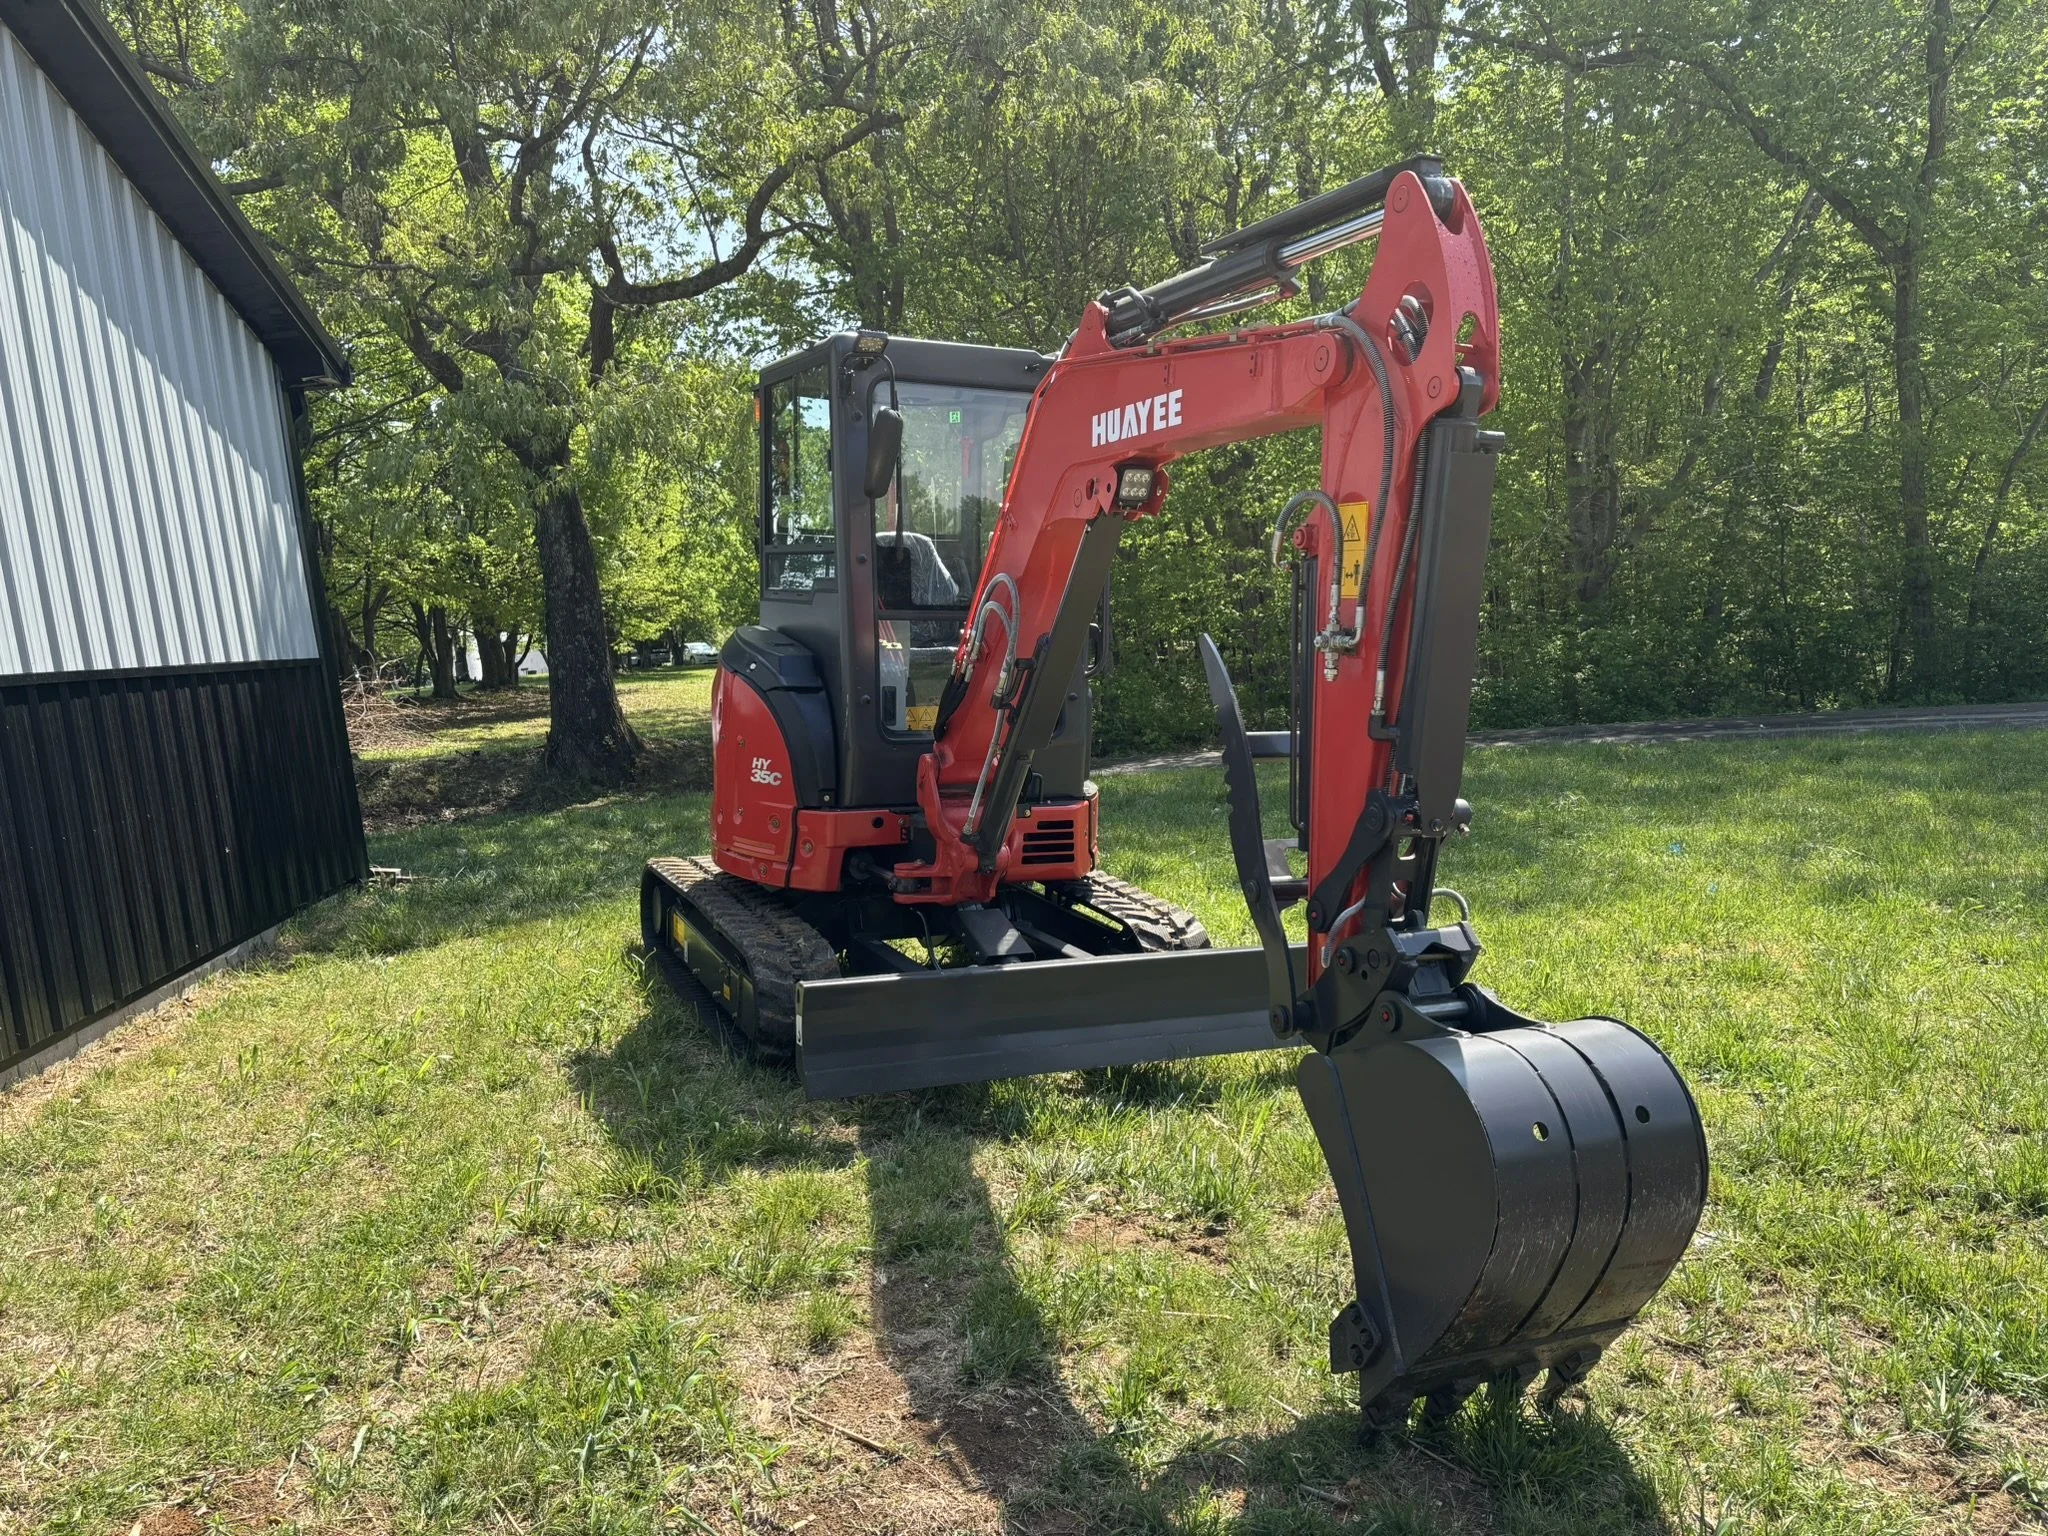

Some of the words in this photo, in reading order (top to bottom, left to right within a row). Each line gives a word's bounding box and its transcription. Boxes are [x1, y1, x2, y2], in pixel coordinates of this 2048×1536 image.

[1092, 389, 1183, 447] HUAYEE
[752, 757, 772, 770] HY
[750, 769, 782, 786] 35C
